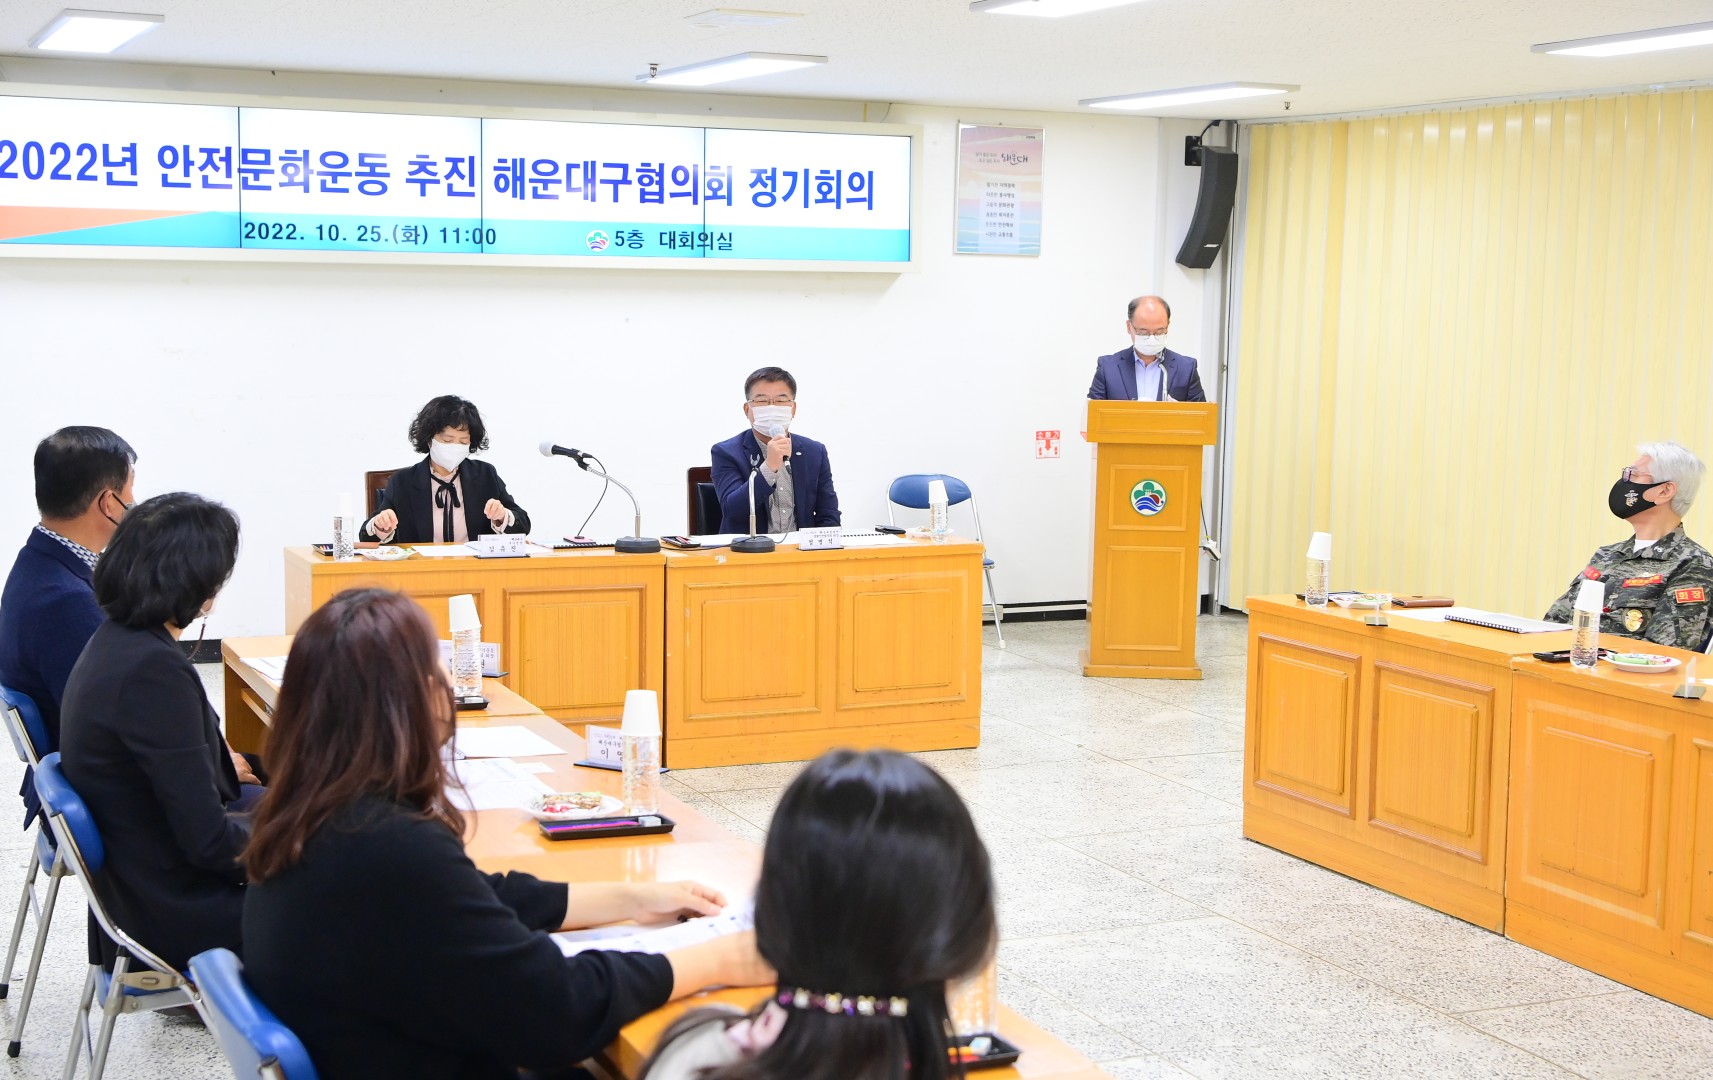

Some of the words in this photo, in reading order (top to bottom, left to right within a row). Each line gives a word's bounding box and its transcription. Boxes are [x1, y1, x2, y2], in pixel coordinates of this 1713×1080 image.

[0, 139, 138, 187] 2022년
[157, 144, 391, 197] 안전문화운동
[405, 154, 476, 198] 추진
[492, 157, 733, 207] 해운대구협의회
[748, 166, 875, 211] 정기회의
[243, 222, 304, 241] 2022.
[315, 223, 347, 242] 10.
[356, 223, 429, 246] 25.(화)
[439, 226, 497, 246] 11:00
[614, 229, 645, 249] 5층
[658, 230, 733, 251] 대회의실
